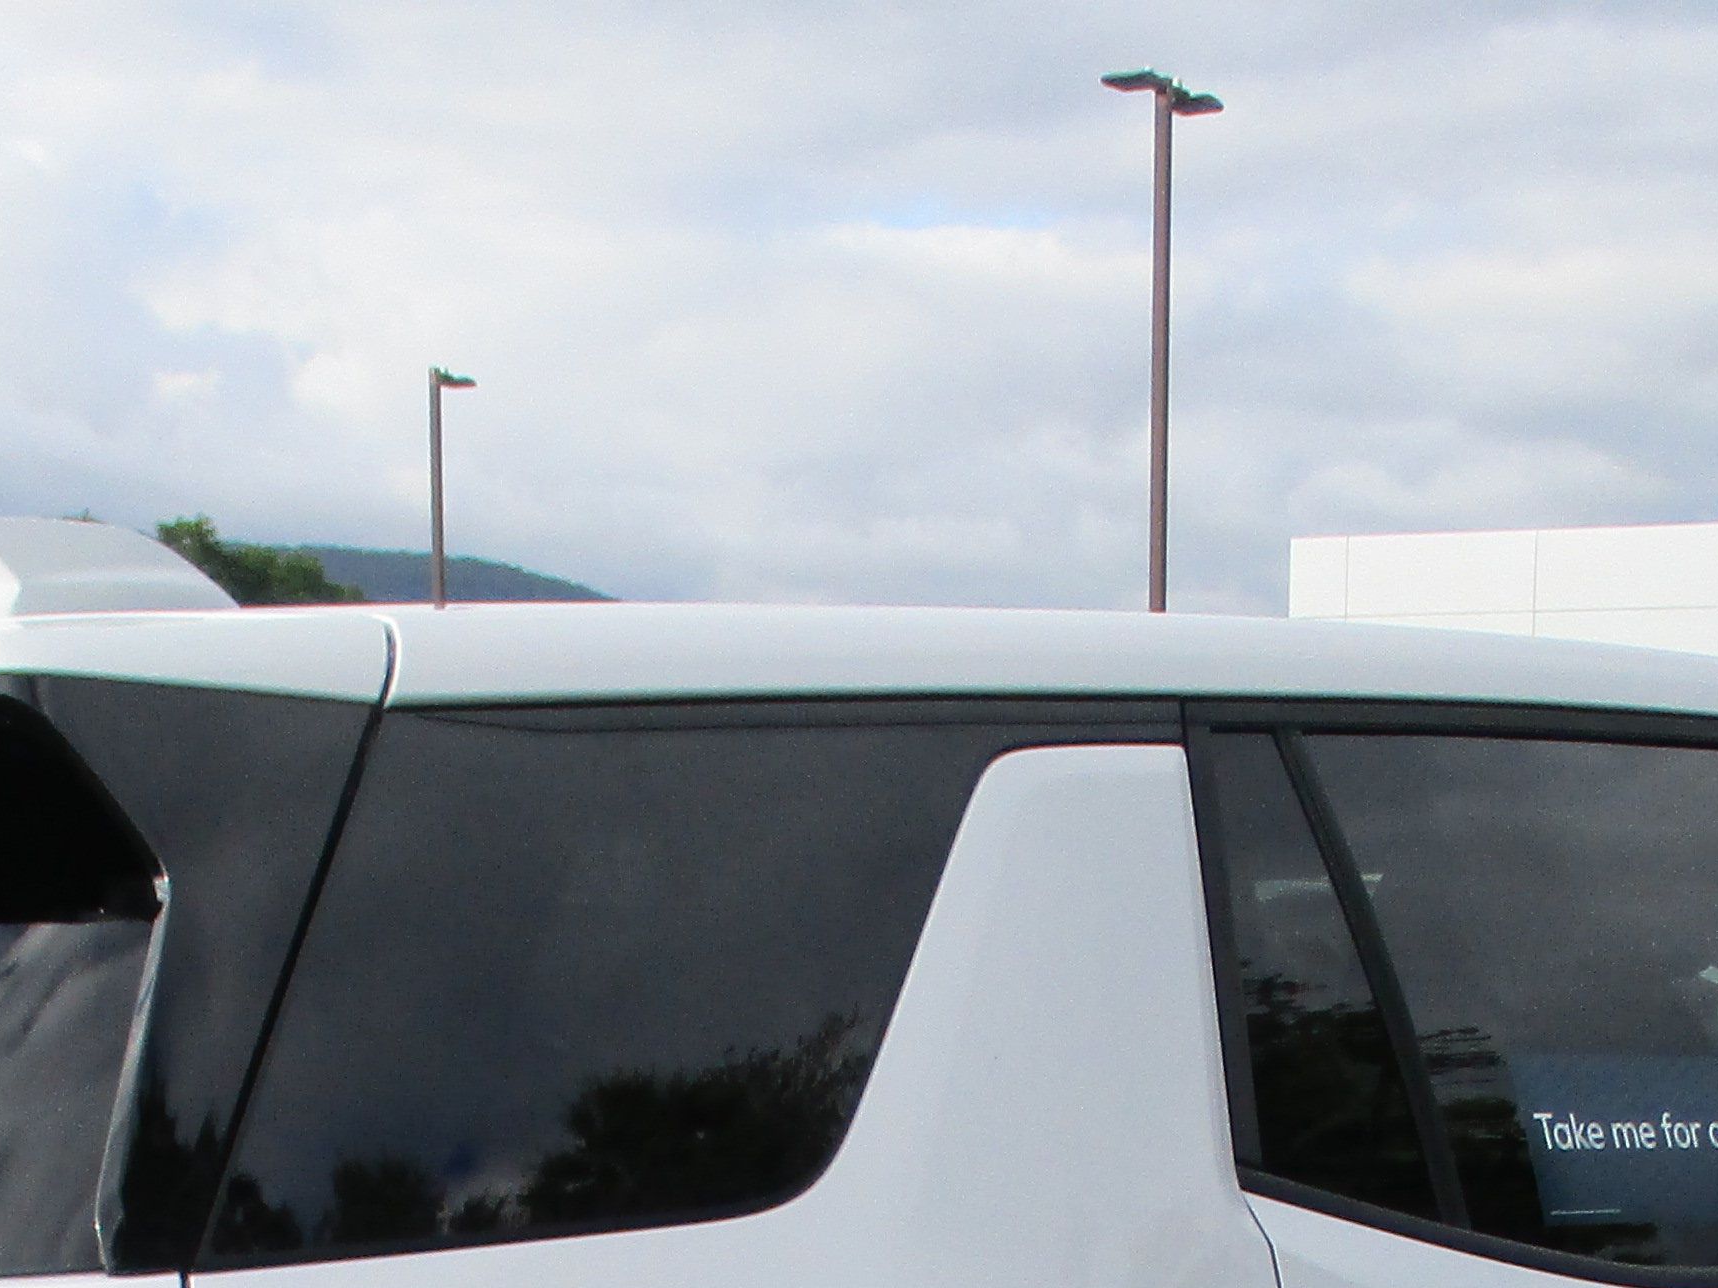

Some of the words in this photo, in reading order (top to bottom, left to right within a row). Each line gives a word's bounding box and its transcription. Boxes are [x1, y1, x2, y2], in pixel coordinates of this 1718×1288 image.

[1533, 1112, 1605, 1150] Take
[1610, 1119, 1657, 1149] me
[1660, 1111, 1701, 1149] for
